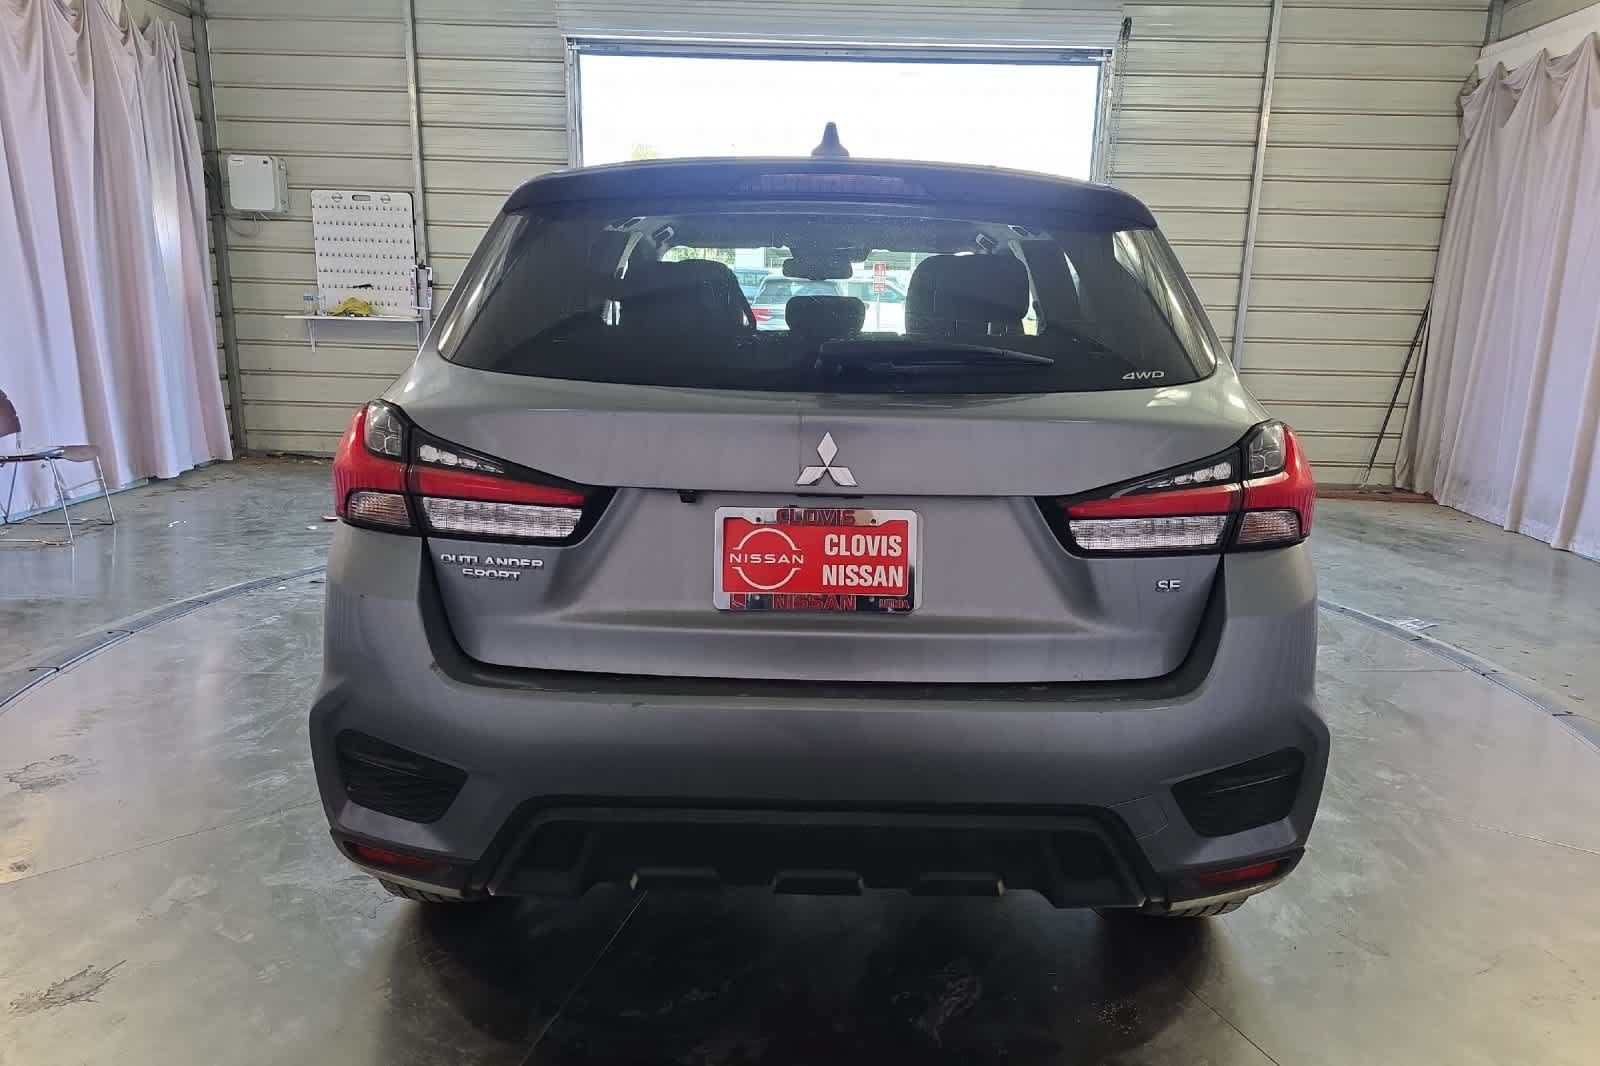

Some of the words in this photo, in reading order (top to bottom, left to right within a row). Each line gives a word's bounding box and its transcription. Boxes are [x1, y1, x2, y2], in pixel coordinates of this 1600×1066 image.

[1122, 370, 1165, 380] 4WD
[776, 508, 857, 526] CLOVIS
[824, 533, 902, 557] CLOVIS
[729, 553, 805, 564] NISSAN
[822, 564, 904, 588] NISSAN
